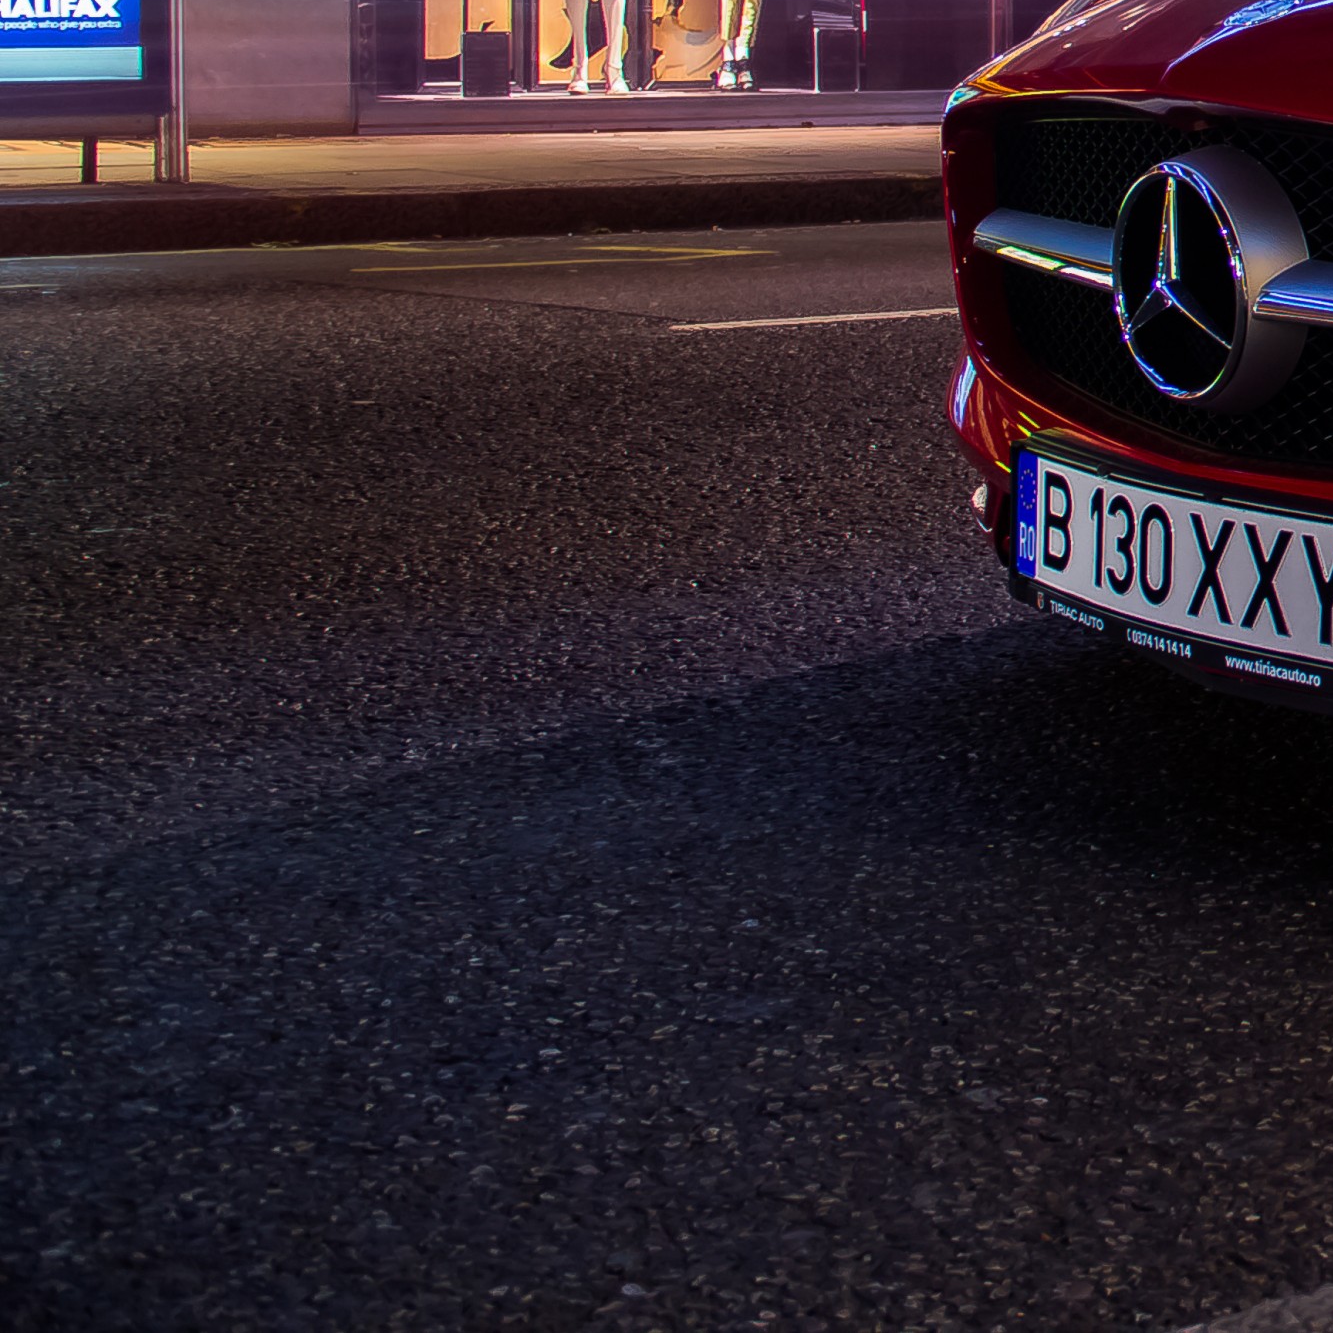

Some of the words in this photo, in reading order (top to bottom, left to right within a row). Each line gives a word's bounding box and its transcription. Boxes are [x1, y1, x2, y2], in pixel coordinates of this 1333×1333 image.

[1019, 522, 1036, 563] RO
[1041, 468, 1074, 573] B
[1089, 485, 1175, 607] 130
[1078, 611, 1105, 631] AUTO
[1224, 653, 1322, 688] www.tiriacauto.ro
